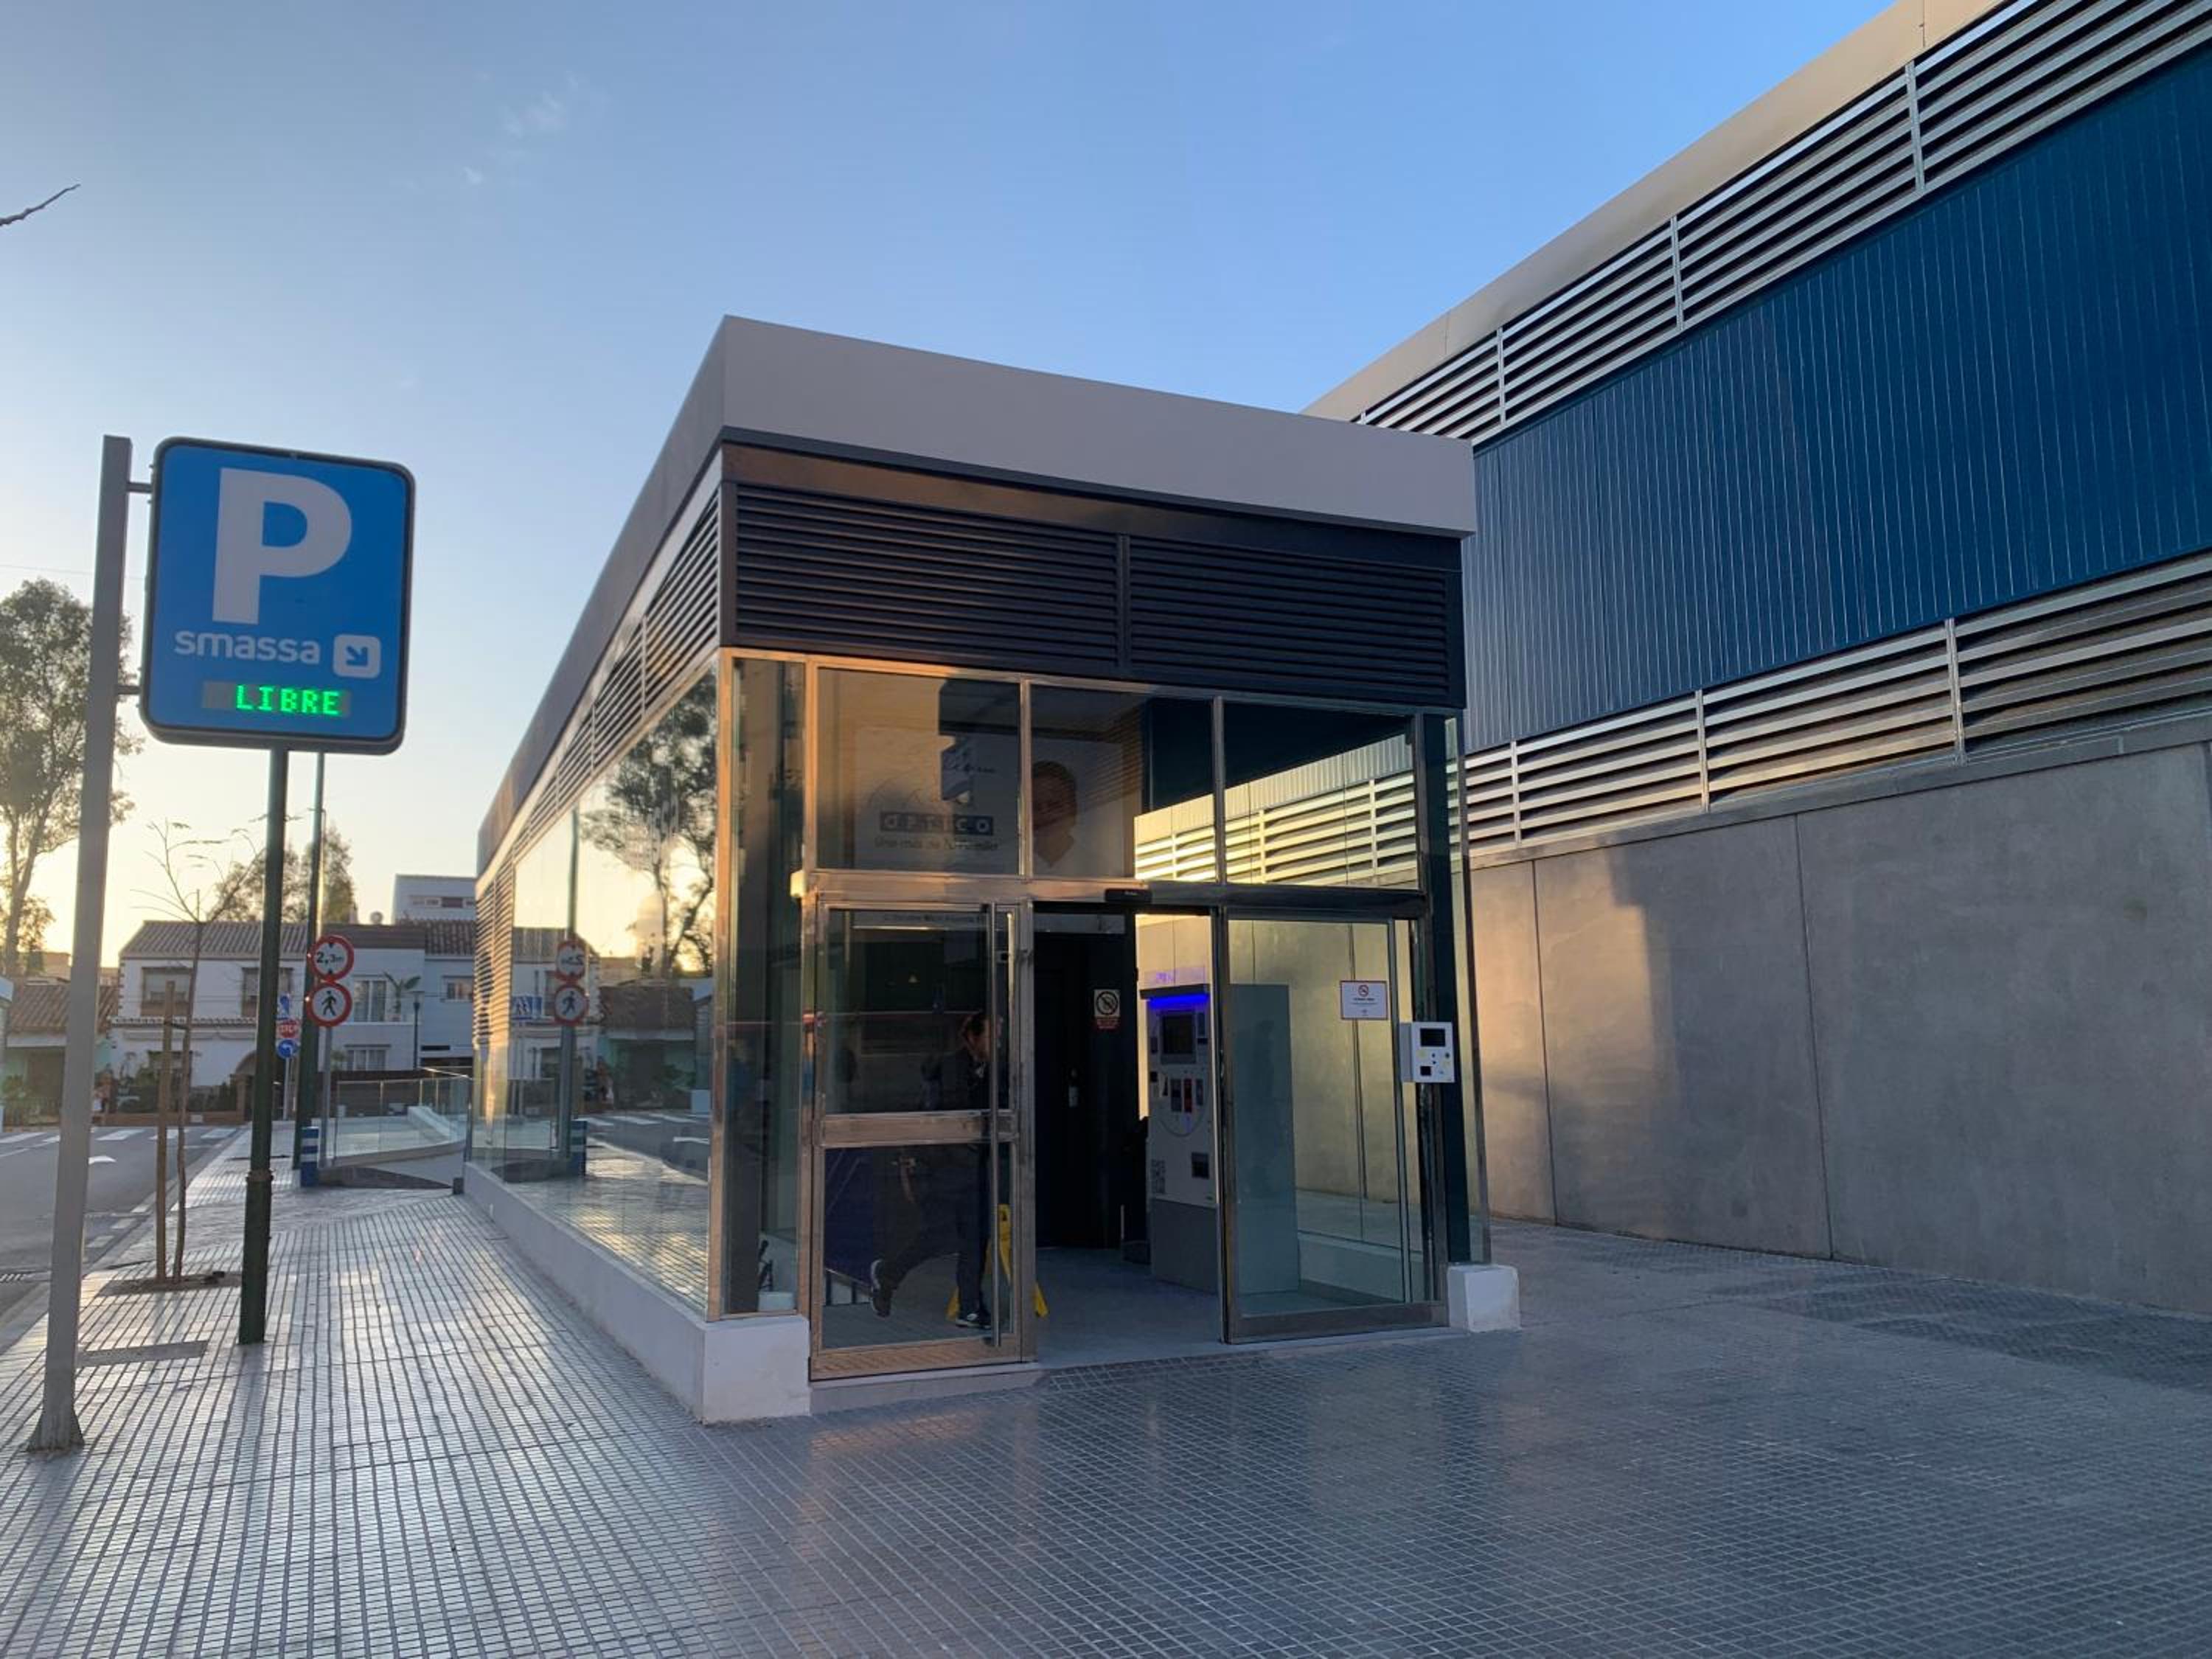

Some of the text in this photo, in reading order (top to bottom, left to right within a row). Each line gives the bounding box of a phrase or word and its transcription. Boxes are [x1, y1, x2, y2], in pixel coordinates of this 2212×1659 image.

[212, 467, 352, 625] P
[174, 630, 321, 664] smassa
[237, 684, 341, 716] LIBRE
